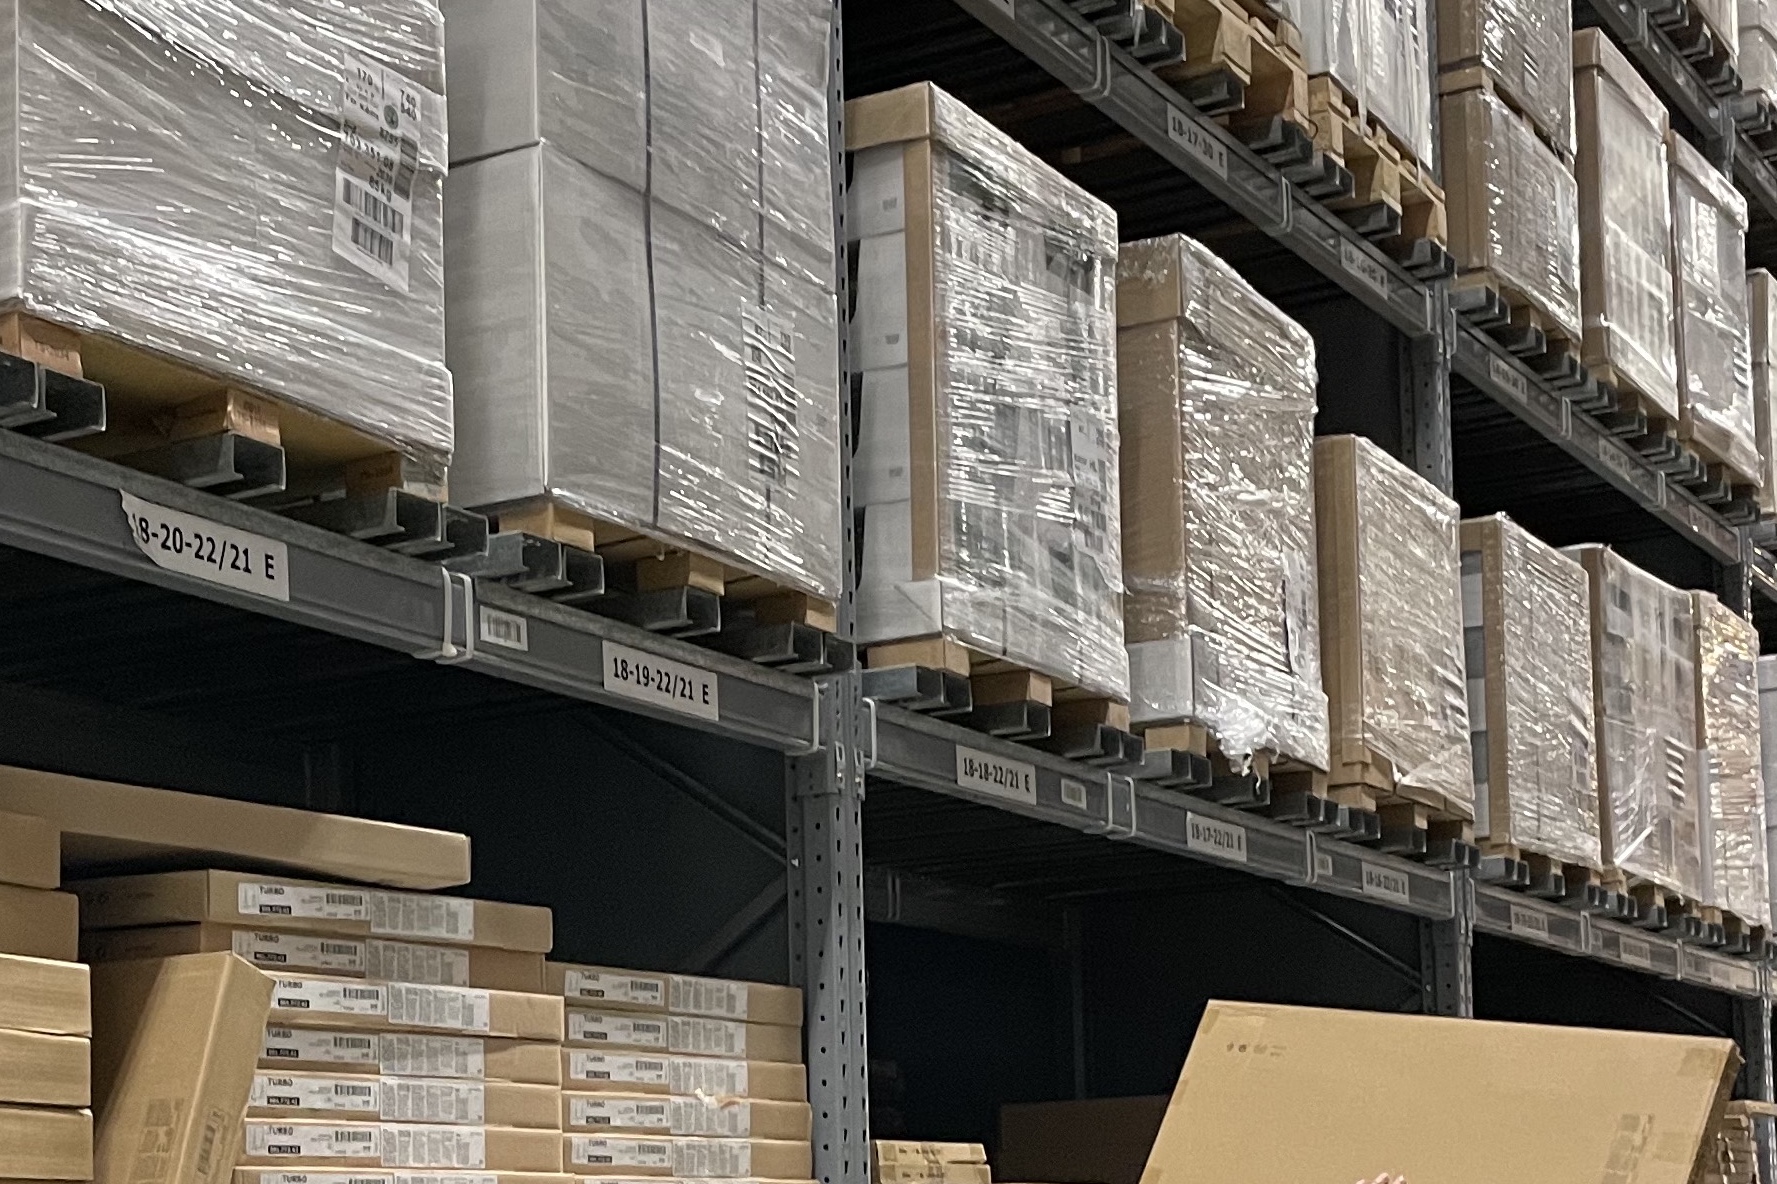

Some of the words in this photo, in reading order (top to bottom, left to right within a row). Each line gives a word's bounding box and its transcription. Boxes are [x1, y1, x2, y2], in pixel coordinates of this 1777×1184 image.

[264, 553, 275, 580] E
[613, 656, 694, 701] 18-19-22/21
[702, 683, 709, 705] E
[963, 757, 1020, 789] 18-18-22/21
